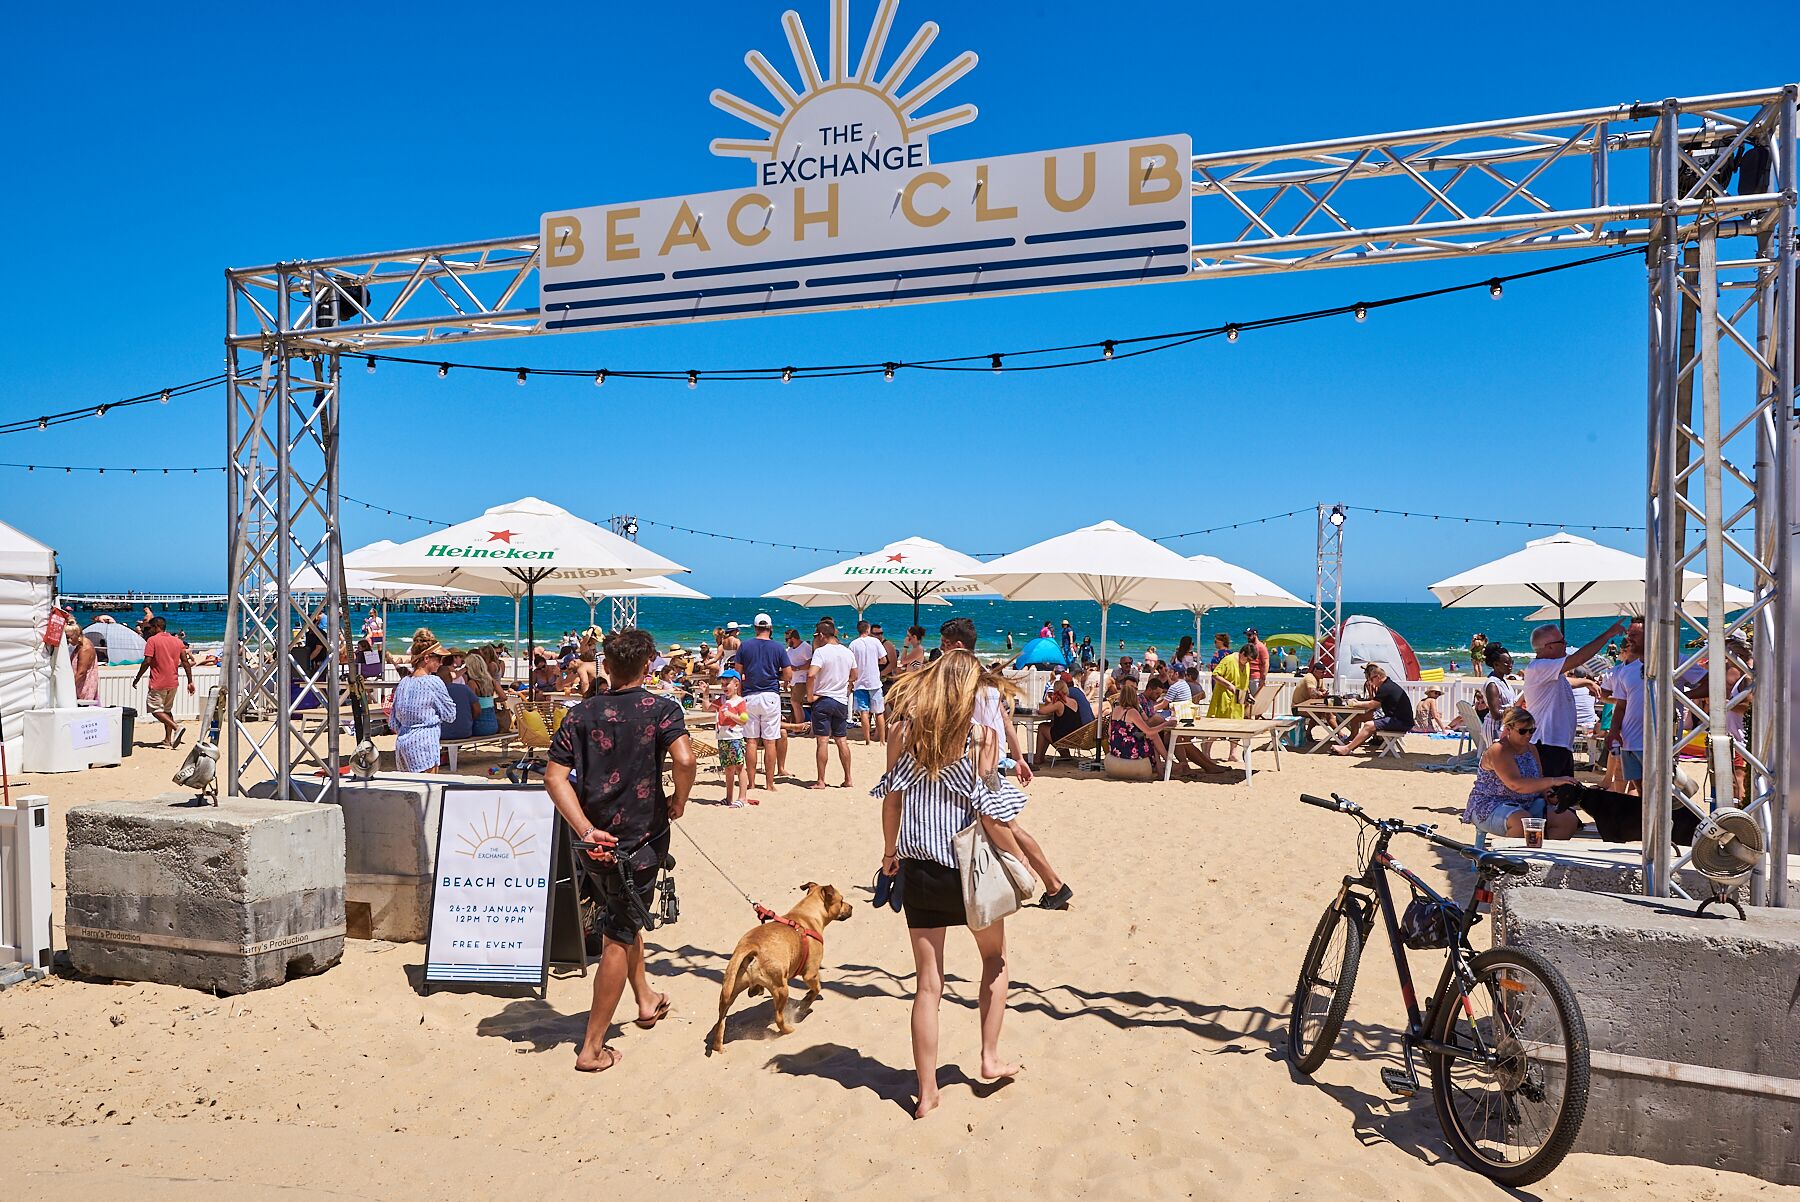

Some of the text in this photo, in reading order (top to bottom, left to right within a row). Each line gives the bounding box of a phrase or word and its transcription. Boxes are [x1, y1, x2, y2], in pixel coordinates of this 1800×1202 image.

[818, 123, 863, 146] THE
[762, 143, 924, 186] EXCHANGE
[546, 143, 1184, 268] BEACH CLUB
[424, 545, 555, 560] Heineken
[844, 565, 933, 575] Heineken
[443, 877, 546, 888] BEACH CLUB
[482, 905, 534, 913] JANUARY
[81, 929, 141, 941] Harry's Production
[239, 934, 309, 954] Harry's Production
[452, 941, 523, 949] FREE EVENT
